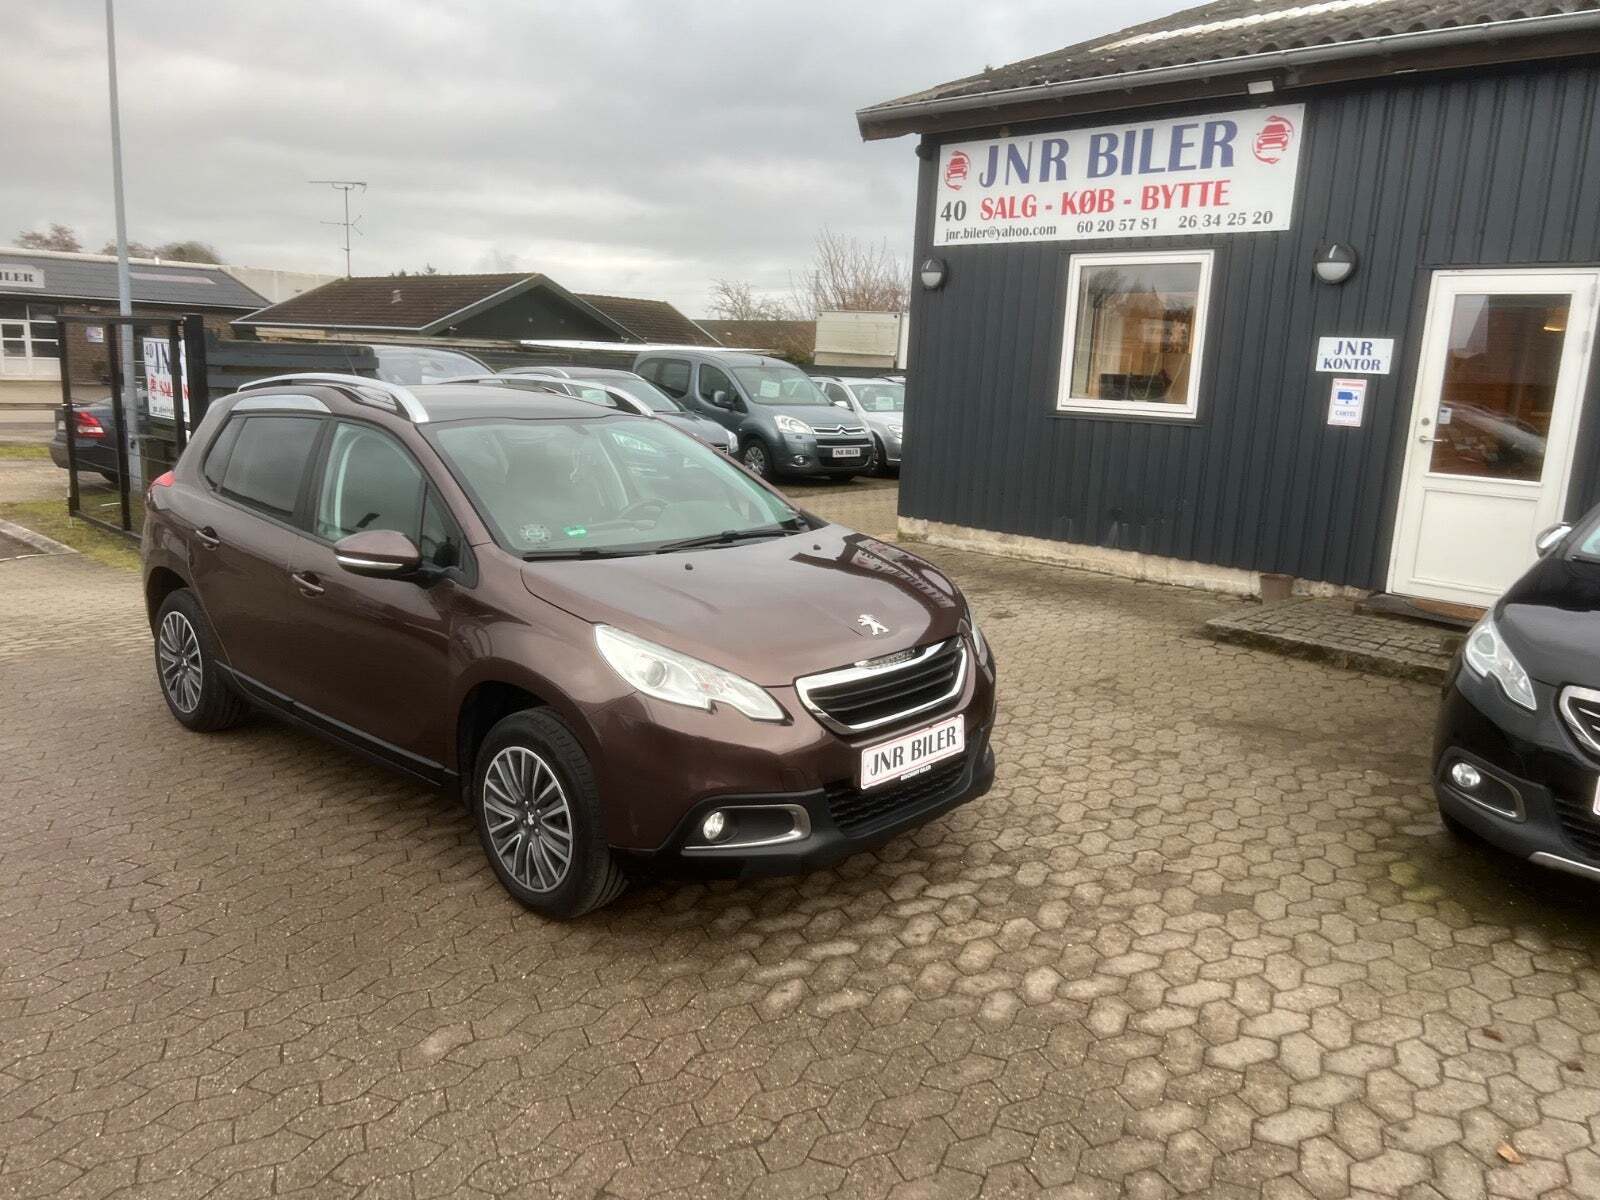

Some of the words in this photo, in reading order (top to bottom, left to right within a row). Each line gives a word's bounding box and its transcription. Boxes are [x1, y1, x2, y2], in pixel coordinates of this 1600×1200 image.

[979, 138, 1070, 188] JNR
[1087, 119, 1239, 178] BILER
[980, 193, 1038, 221] SALG
[1060, 188, 1114, 216] KØB
[1141, 180, 1231, 210] BYTTE
[940, 200, 967, 222] 40
[1178, 215, 1197, 229] 26
[1198, 213, 1221, 228] 34
[1227, 212, 1246, 226] 25
[1252, 211, 1273, 225] 20
[945, 223, 1057, 241] jnr.biler@yahoo.com
[1077, 220, 1093, 233] 60
[1097, 219, 1115, 233] 20
[1119, 218, 1137, 231] 57
[1140, 217, 1158, 230] 81
[1334, 341, 1373, 355] JNR
[1323, 358, 1381, 370] KONTOR
[870, 746, 904, 776] JNR
[911, 725, 957, 761] BILER
